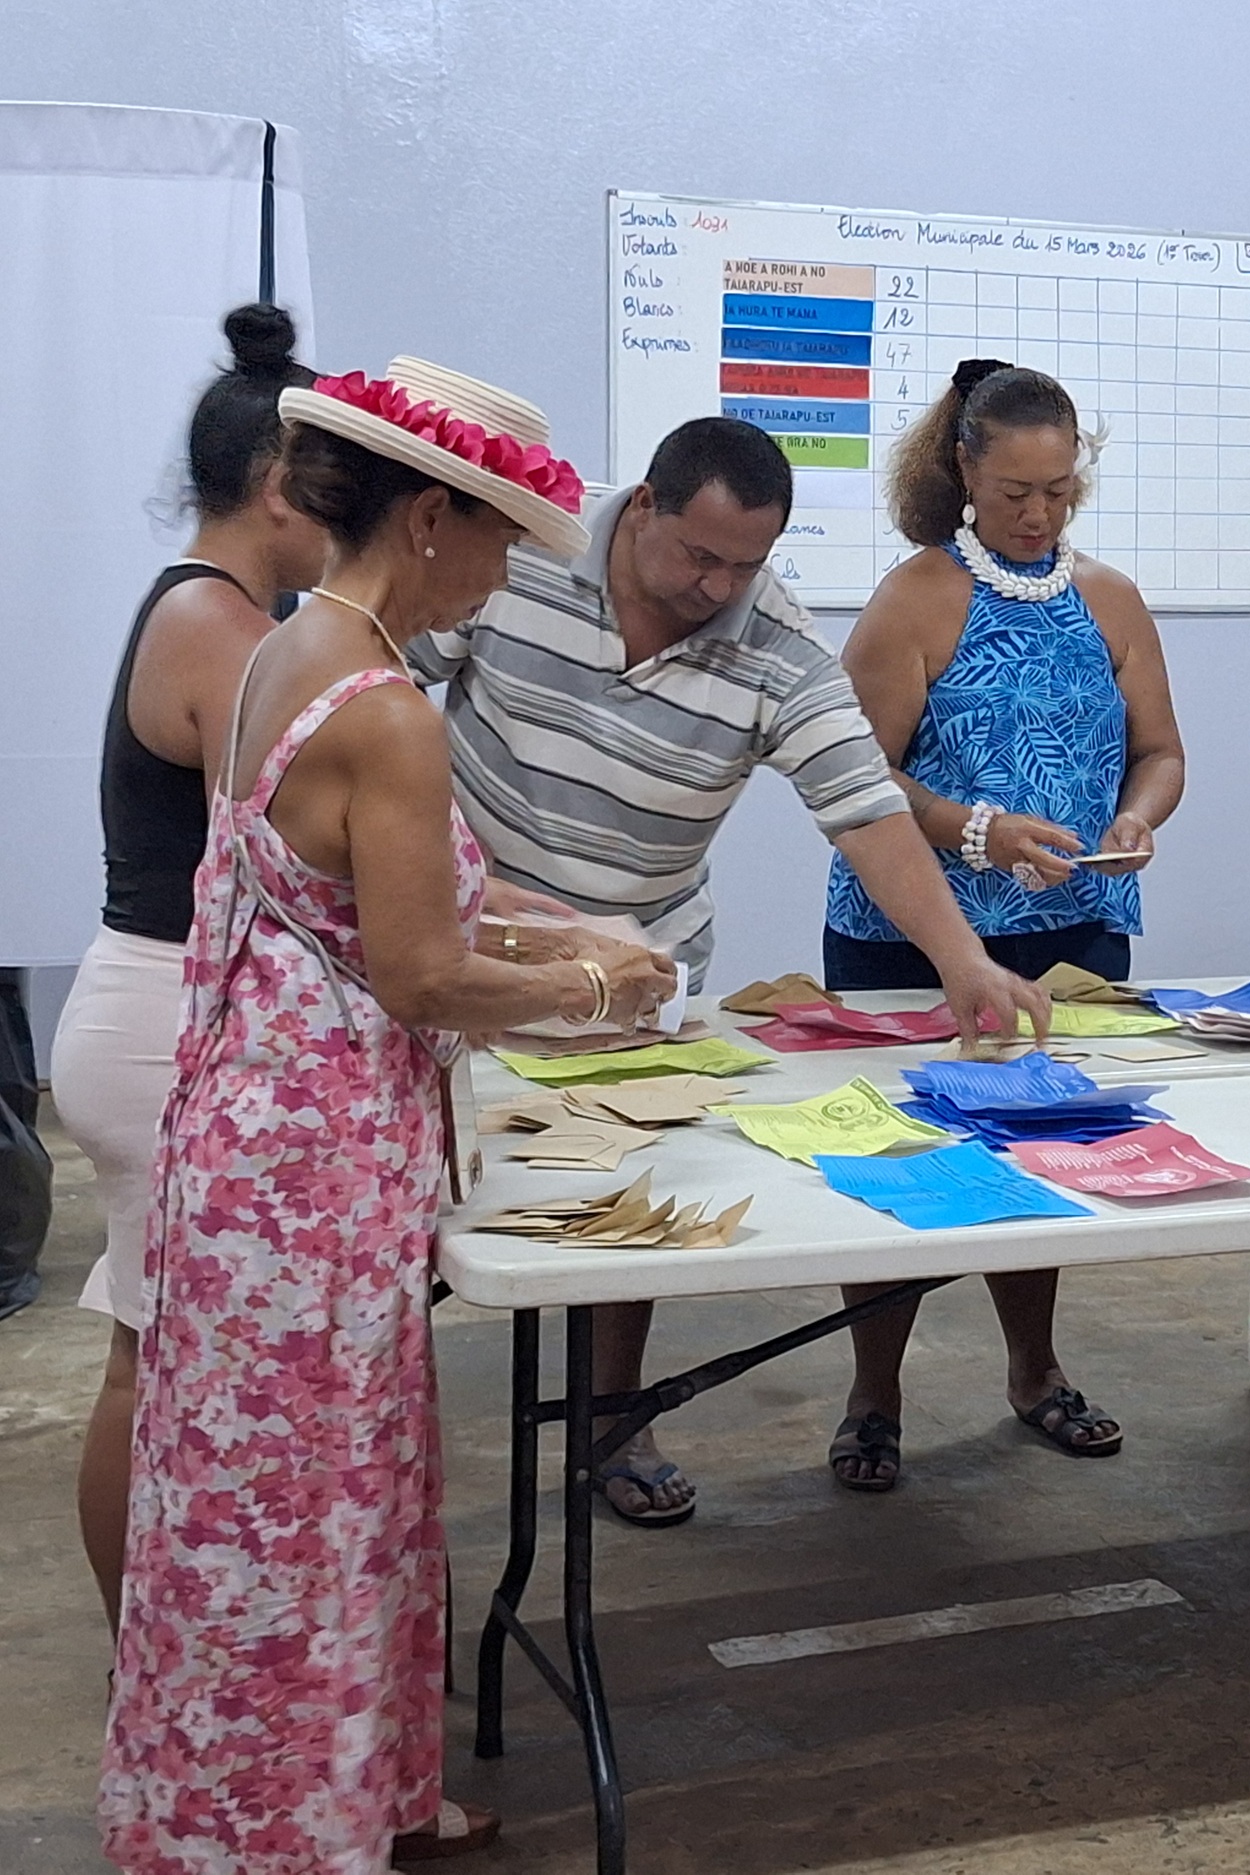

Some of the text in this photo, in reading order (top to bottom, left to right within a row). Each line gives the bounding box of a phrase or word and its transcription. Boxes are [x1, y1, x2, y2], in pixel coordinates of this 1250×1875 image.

[622, 233, 678, 257] Votants
[917, 221, 1005, 254] Municipale
[1012, 229, 1039, 249] du
[1045, 234, 1062, 251] 15
[1067, 236, 1100, 255] Mars
[1106, 241, 1147, 260] 2026
[624, 264, 663, 288] Nuls
[725, 262, 826, 278] A HOE A ROHI A NO
[725, 278, 803, 294] TAIARAPU-EST
[887, 275, 919, 298] 22
[623, 296, 674, 317] Blancs
[738, 306, 768, 318] HURA
[771, 307, 783, 318] TE
[883, 307, 914, 330] 12
[886, 342, 911, 367] 47
[898, 375, 909, 399] 4
[890, 409, 910, 431] 5
[812, 437, 826, 449] NO
